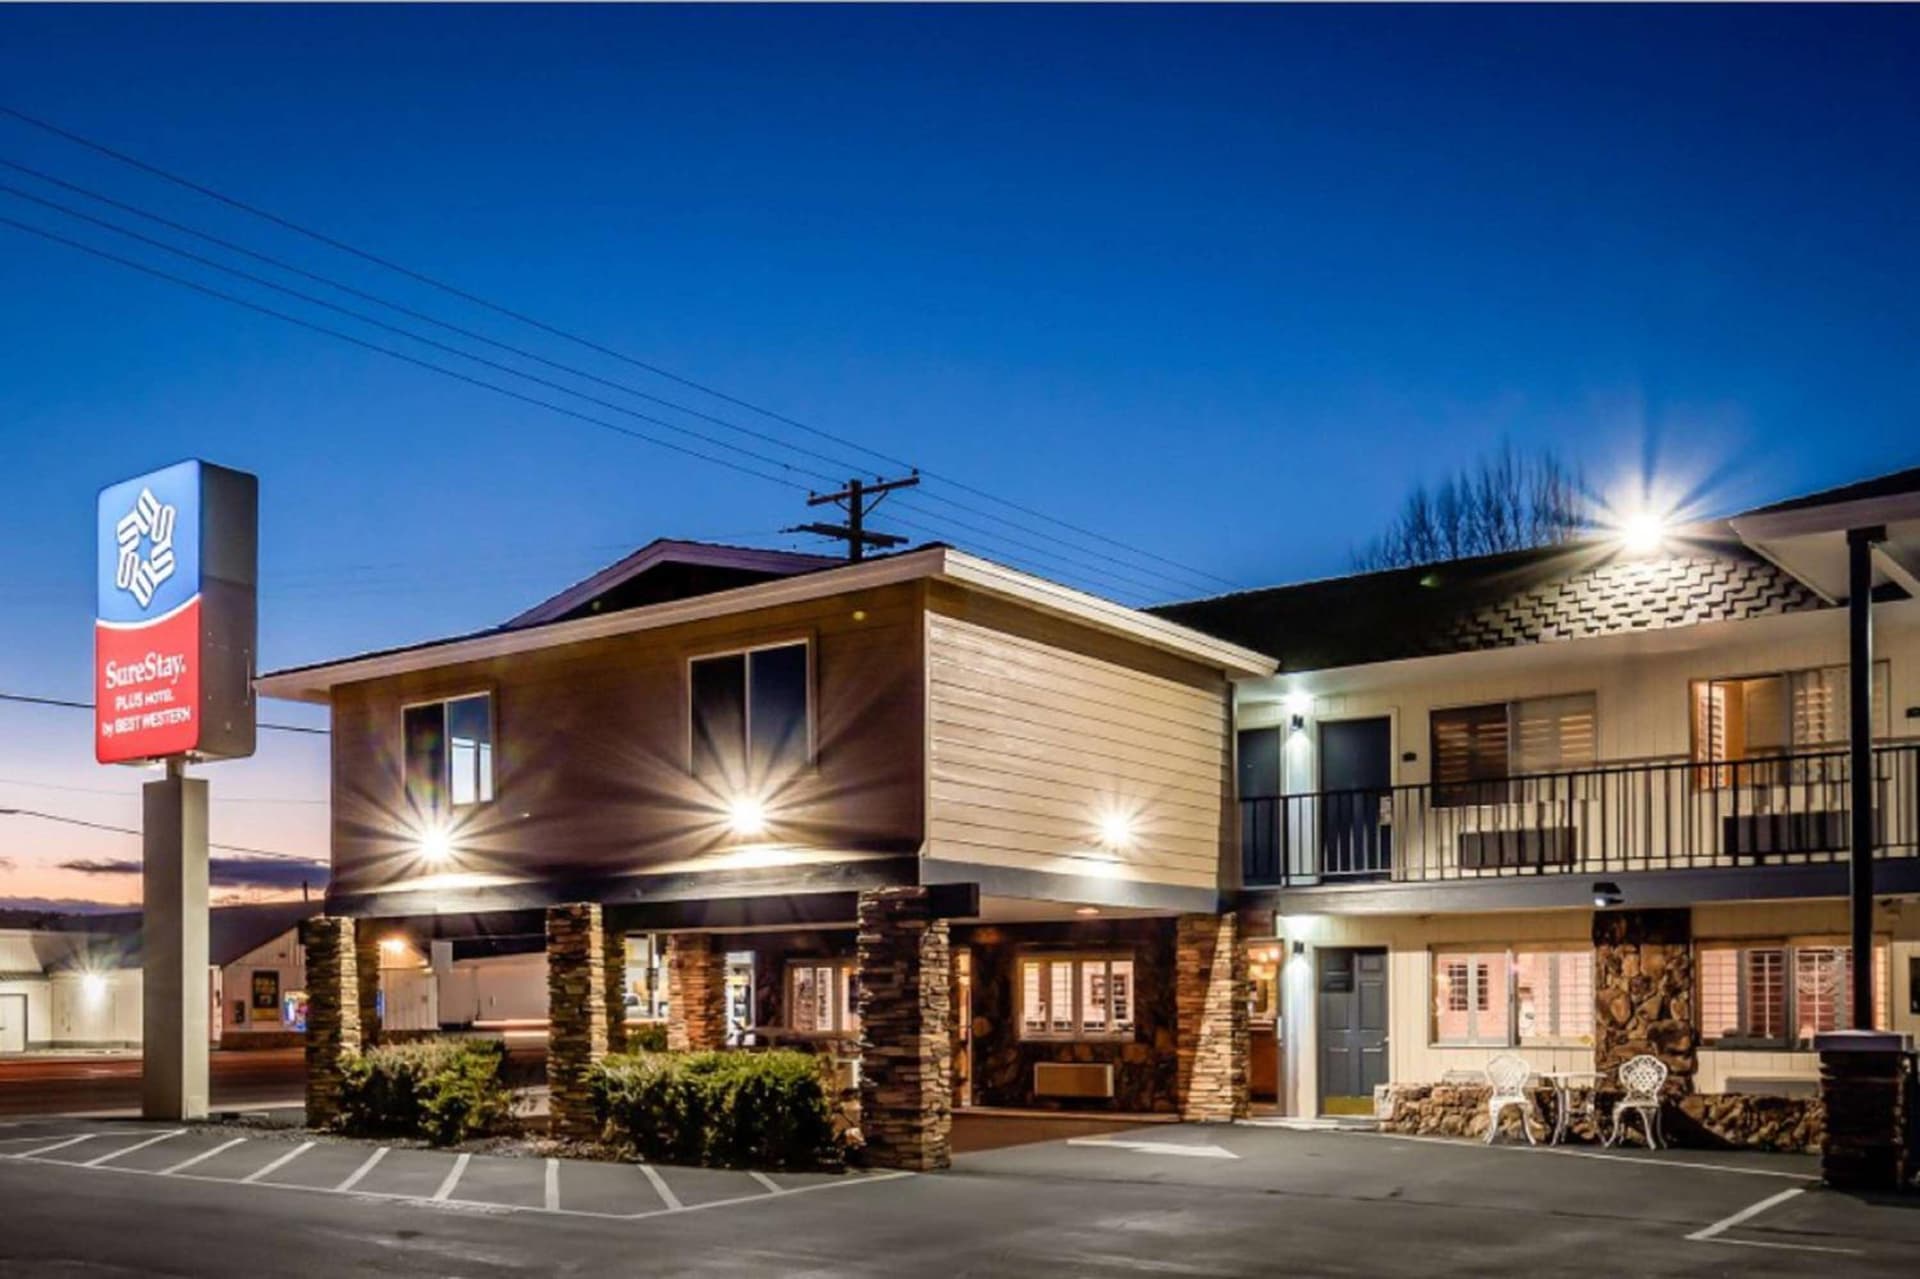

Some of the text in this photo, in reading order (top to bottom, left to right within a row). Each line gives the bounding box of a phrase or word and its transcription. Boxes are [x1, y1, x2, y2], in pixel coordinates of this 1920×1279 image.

[115, 691, 143, 711] PLUS
[115, 715, 142, 734] BEST
[142, 706, 191, 730] WESTERN
